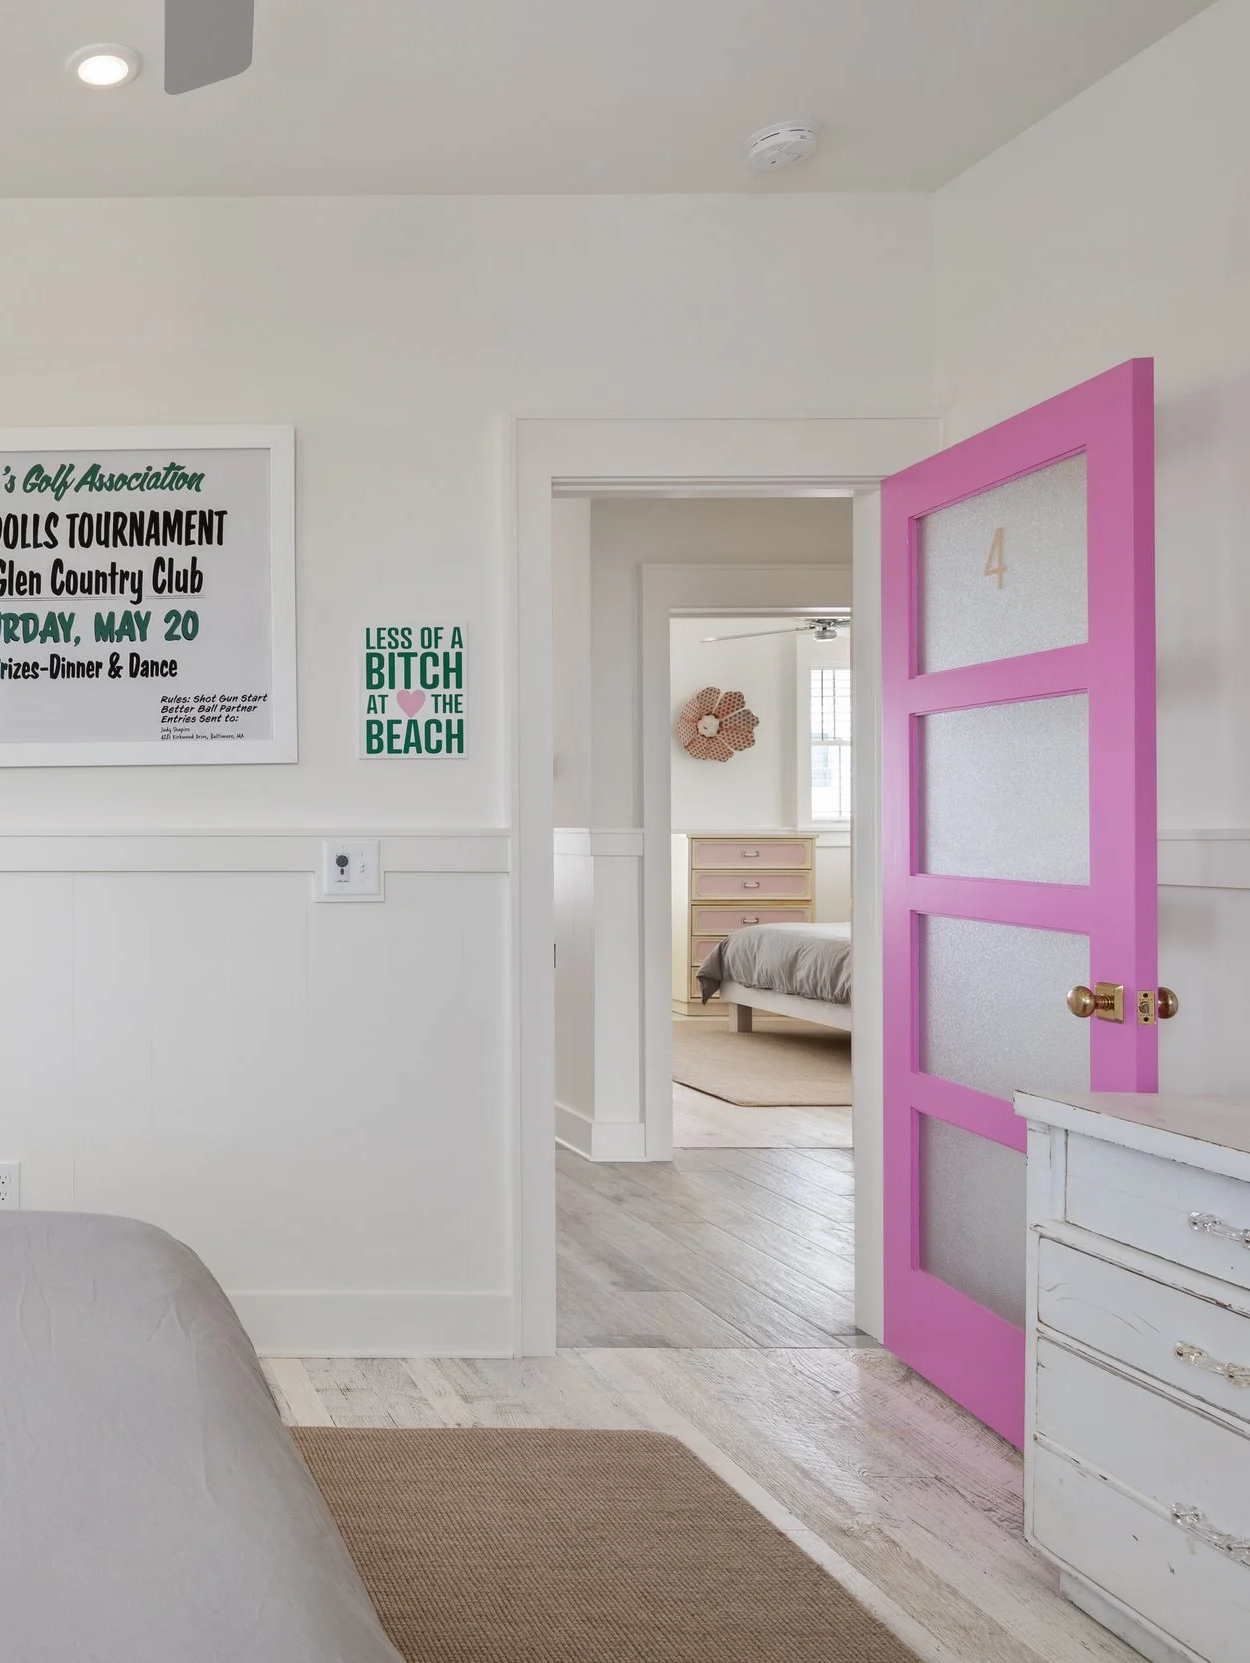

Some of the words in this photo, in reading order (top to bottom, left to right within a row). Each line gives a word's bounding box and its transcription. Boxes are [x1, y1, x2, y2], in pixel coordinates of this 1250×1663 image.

[22, 463, 77, 502] Golf
[74, 462, 206, 494] Association
[66, 509, 229, 548] TOURNAMENT
[984, 526, 1008, 590] 4
[50, 560, 144, 605] Country
[152, 556, 204, 594] Club
[93, 609, 153, 644] MAY
[163, 608, 200, 642] 20
[366, 627, 412, 649] LESS
[420, 626, 444, 649] OF
[451, 626, 463, 649] A
[107, 651, 123, 680] &
[128, 652, 179, 679] Dance
[366, 651, 463, 690] BITCH
[160, 694, 191, 704] Rules:
[193, 693, 217, 703] Shot
[218, 693, 239, 703] Gun
[240, 693, 268, 702] Start
[160, 704, 195, 714] Better
[197, 703, 218, 713] Ball
[219, 702, 258, 713] Partner
[367, 694, 389, 714] AT
[431, 693, 463, 714] THE
[160, 714, 197, 723] Entries
[199, 713, 222, 723] Sent
[224, 713, 239, 723] to:
[366, 718, 464, 754] BEACH
